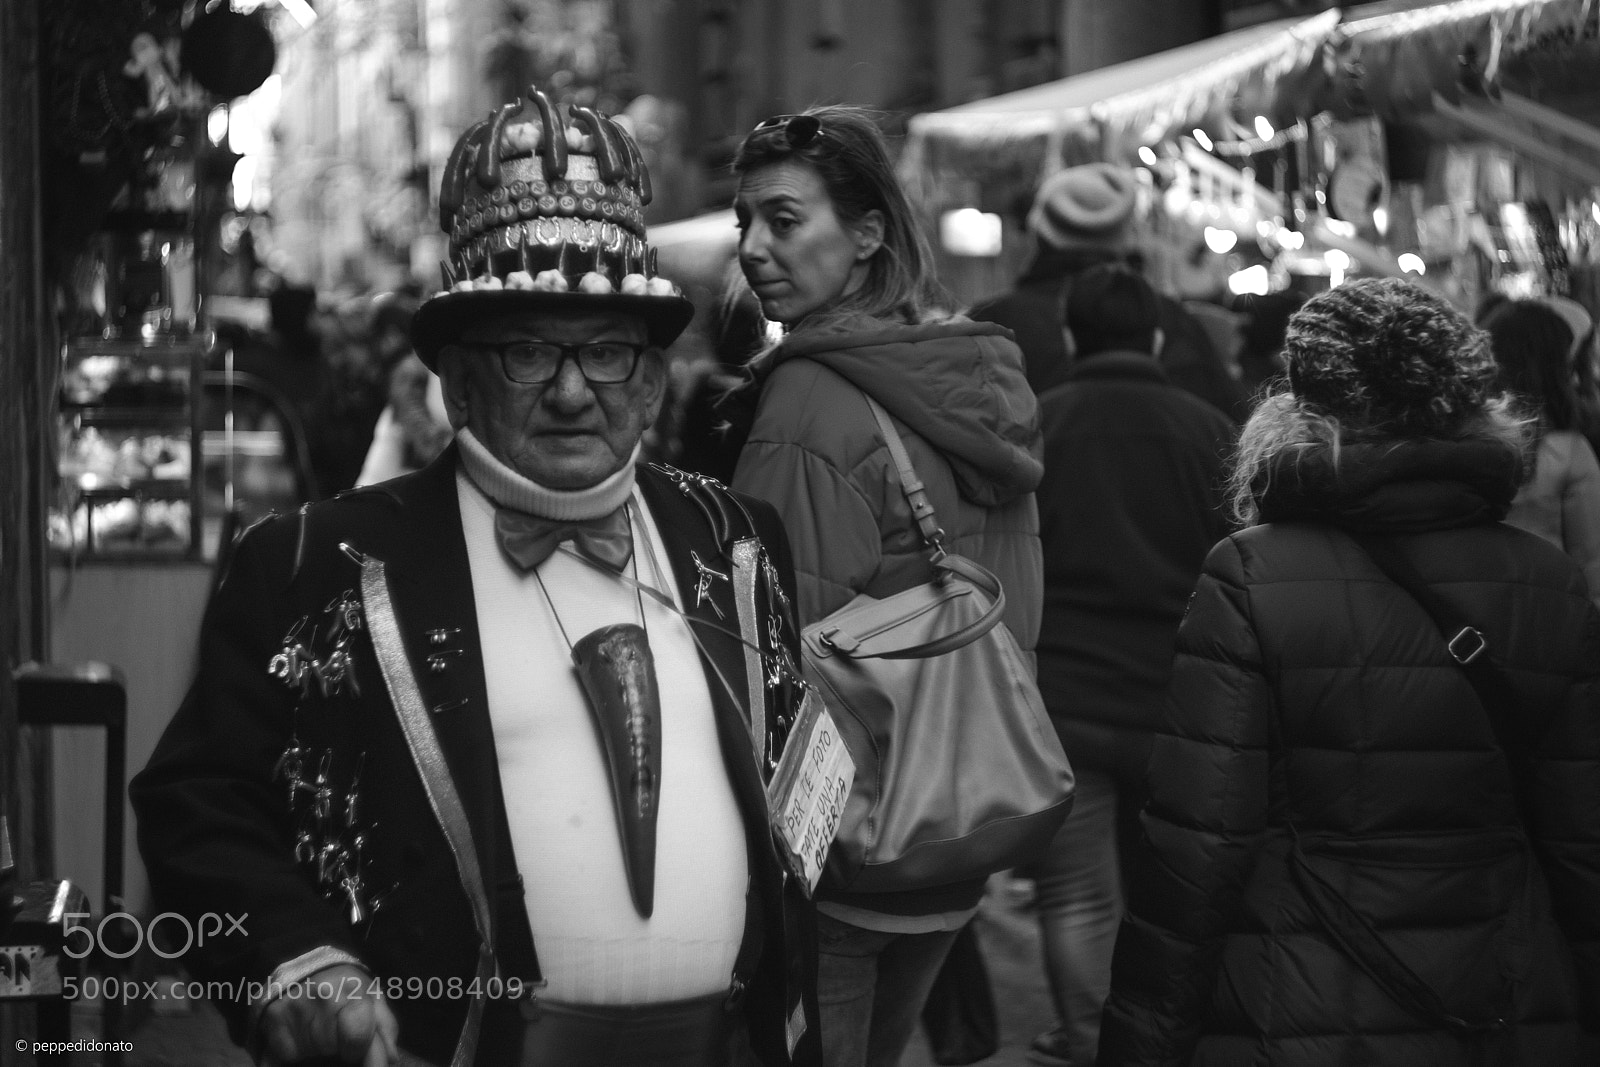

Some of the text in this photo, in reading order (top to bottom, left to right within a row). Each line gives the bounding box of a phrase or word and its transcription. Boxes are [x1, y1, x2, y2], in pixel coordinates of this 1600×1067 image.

[787, 729, 831, 839] PER LE FOTO
[815, 777, 847, 871] OFFERTA
[816, 776, 835, 816] UNA
